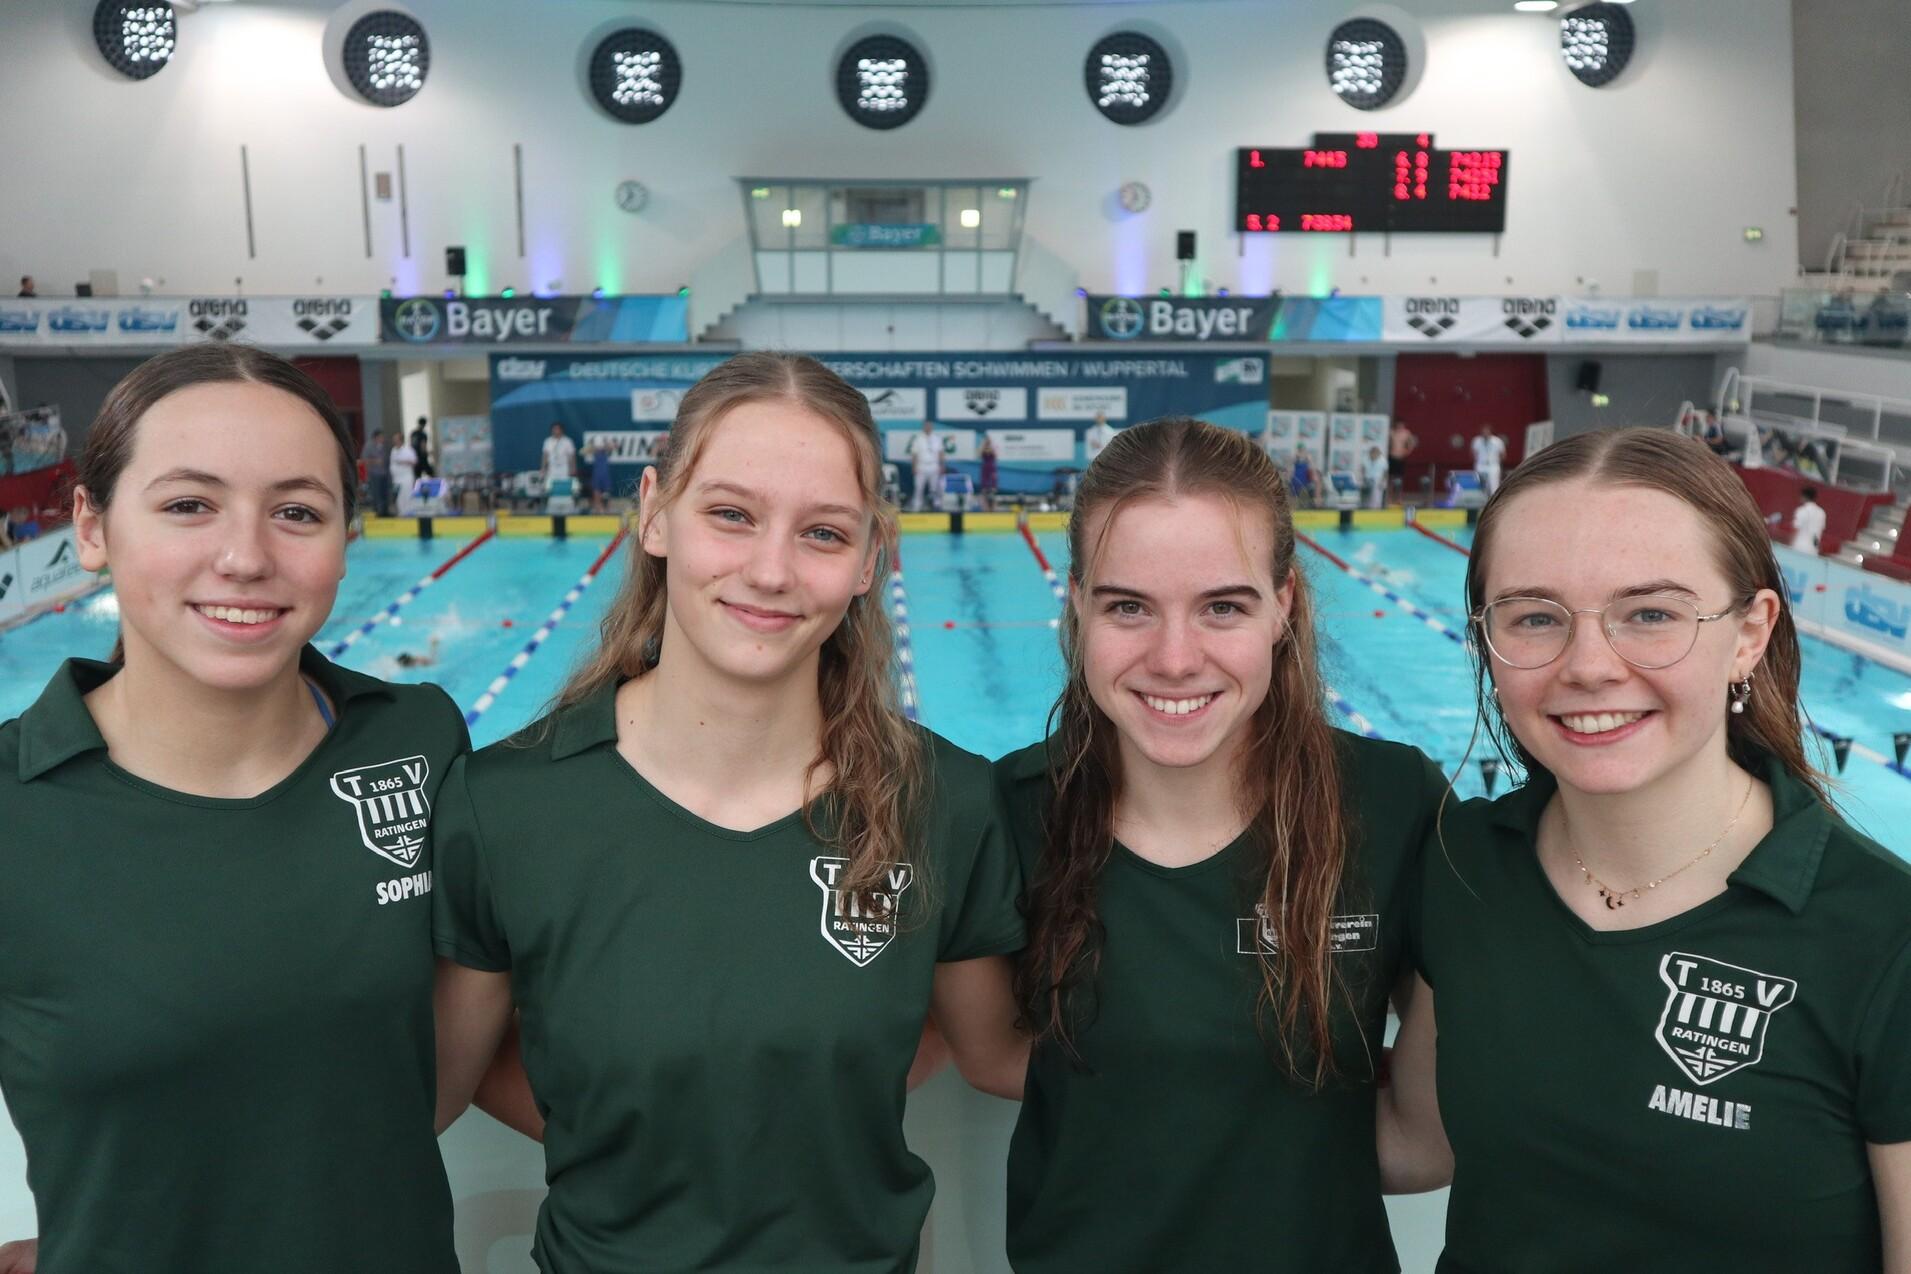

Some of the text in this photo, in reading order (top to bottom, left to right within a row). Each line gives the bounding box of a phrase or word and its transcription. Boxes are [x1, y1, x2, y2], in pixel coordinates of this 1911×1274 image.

[190, 299, 248, 316] arena
[293, 299, 351, 316] arena
[1406, 298, 1459, 314] arena
[1503, 298, 1556, 314] arena
[446, 302, 552, 341] Bayer
[1151, 301, 1253, 340] Bayer
[568, 362, 667, 377] DEUTSCHE
[953, 361, 1067, 378] SCHWIMMEN
[1082, 360, 1188, 378] WUPPERTAL
[343, 763, 420, 796] T 1865 V
[374, 818, 427, 838] RATINGEN
[824, 864, 906, 890] T V
[1676, 960, 1785, 1008] T 1865 V
[1672, 1026, 1750, 1056] RATINGEN
[1648, 1084, 1751, 1130] AMELIE
